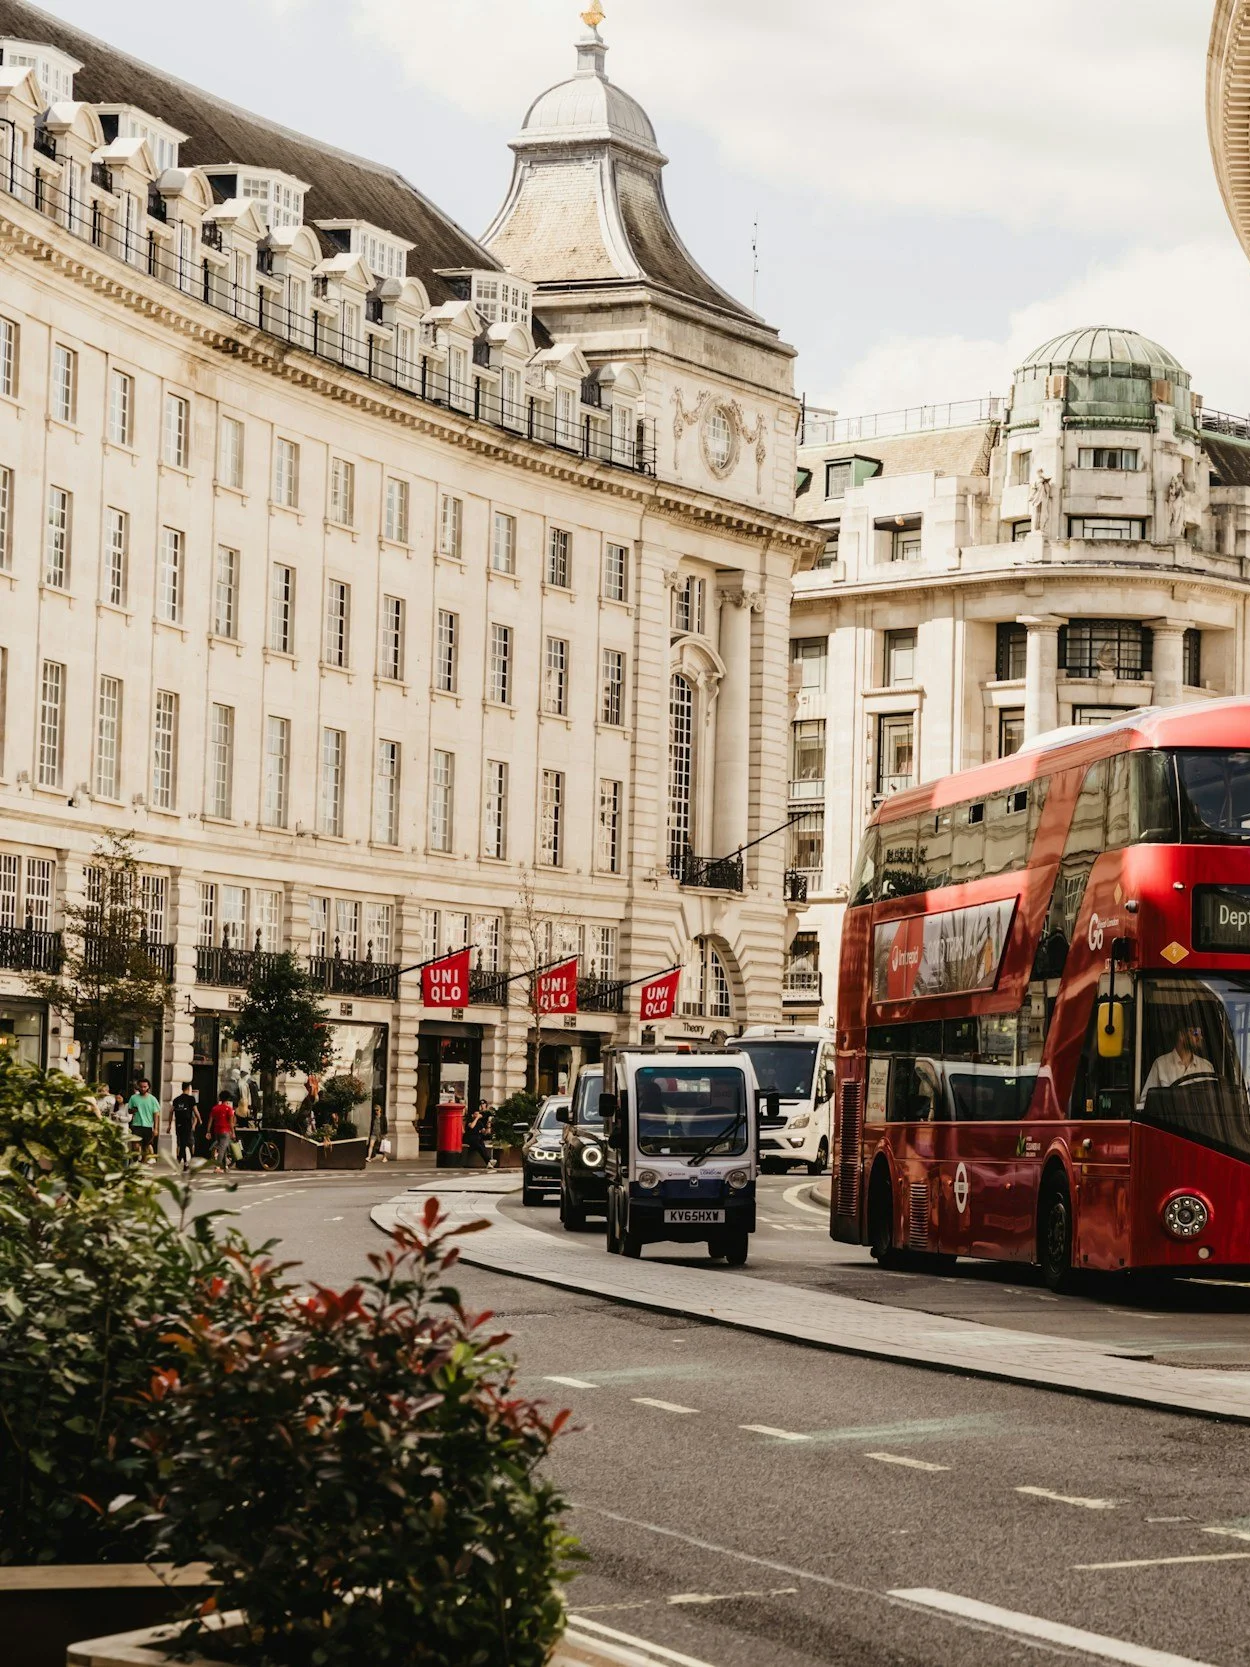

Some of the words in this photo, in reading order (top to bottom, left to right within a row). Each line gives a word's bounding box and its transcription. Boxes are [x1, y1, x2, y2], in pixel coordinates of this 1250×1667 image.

[1088, 912, 1104, 951] Go
[430, 968, 459, 984] UNI
[541, 976, 567, 992] UNI
[430, 985, 462, 1002] QLO
[646, 985, 669, 1000] UNI
[540, 993, 569, 1010] QLO
[645, 1001, 668, 1017] QLO
[683, 1022, 705, 1035] Theory
